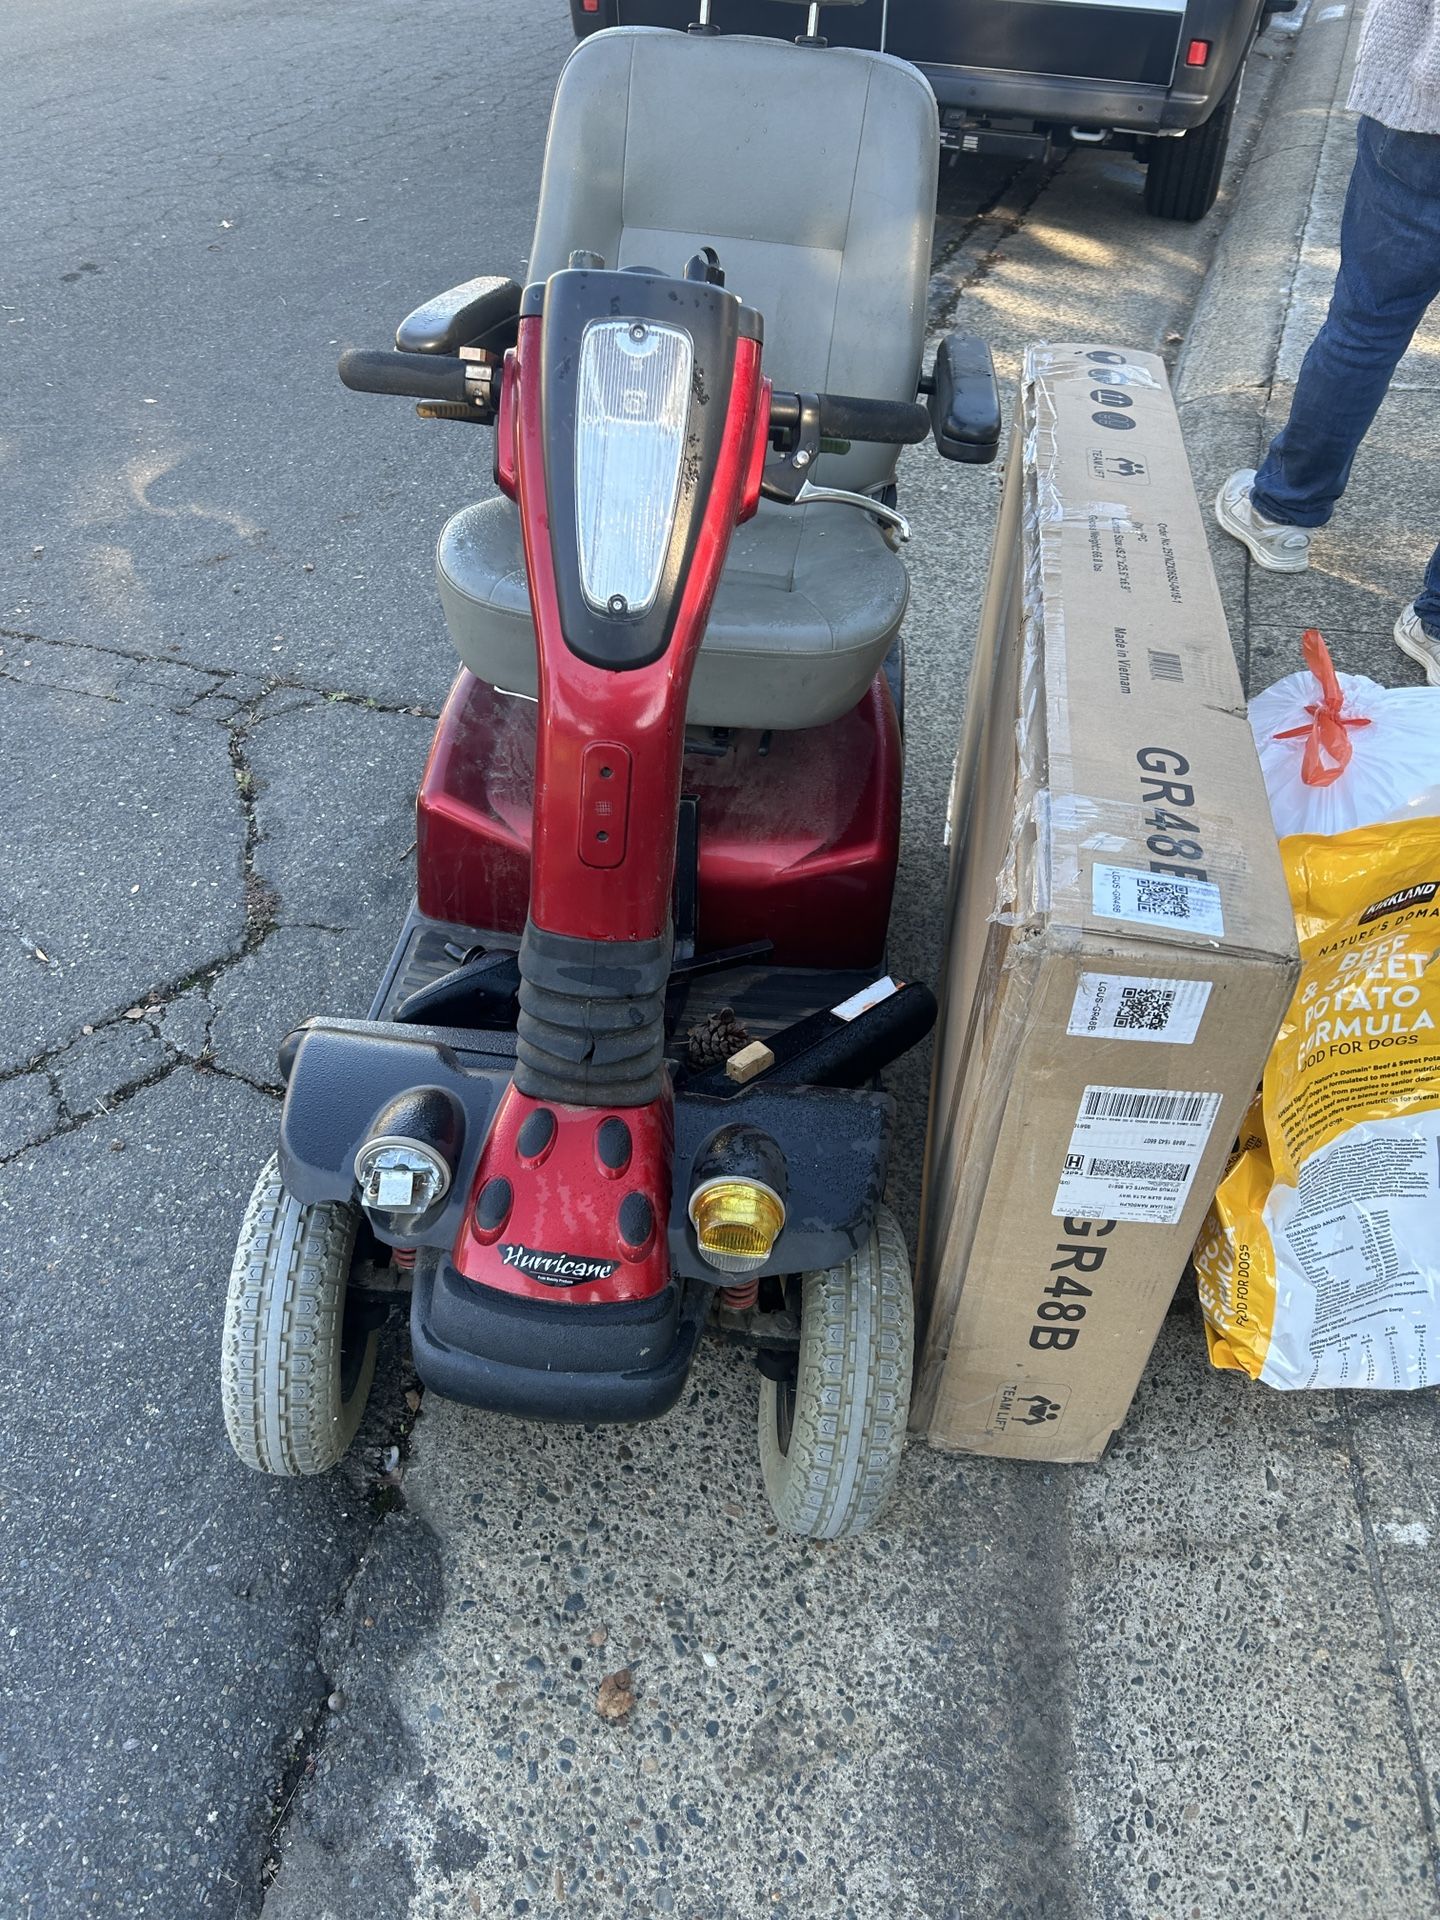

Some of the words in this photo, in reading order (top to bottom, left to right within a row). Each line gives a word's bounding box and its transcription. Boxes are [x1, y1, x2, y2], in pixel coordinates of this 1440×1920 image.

[1092, 450, 1103, 468] TEAM
[1094, 466, 1105, 479] LIFT
[1114, 627, 1127, 649] Made
[1117, 650, 1127, 658] in
[1118, 658, 1131, 694] Vietnam
[1111, 871, 1122, 914] LGUS-GR48B
[1367, 883, 1436, 915] KIRKLAND
[1319, 921, 1388, 957] NATURE'S
[1338, 934, 1411, 972] BEEF
[1087, 981, 1108, 1032] LGUS-GR48B
[1305, 985, 1421, 1032] POTATO
[1329, 1041, 1362, 1057] FOR
[1368, 1035, 1419, 1050] DOGS
[1314, 1072, 1339, 1086] Nature's
[1373, 1062, 1391, 1072] Beef
[1399, 1057, 1422, 1067] Sweet
[1329, 1076, 1368, 1088] formulated
[1380, 1071, 1399, 1079] meet
[1308, 1108, 1323, 1119] Angus
[1323, 1099, 1335, 1110] beef
[1336, 1096, 1350, 1105] and
[1357, 1090, 1378, 1100] blend
[1389, 1086, 1416, 1096] quality
[1331, 1088, 1349, 1097] from
[1350, 1083, 1379, 1094] puppies
[1391, 1079, 1413, 1087] senior
[1328, 1106, 1345, 1118] offers
[1346, 1102, 1365, 1111] great
[503, 1246, 612, 1279] Hurricane
[1239, 1244, 1250, 1282] DOGS
[1029, 1217, 1117, 1350] GR48B
[1238, 1282, 1249, 1304] FOR
[999, 1384, 1017, 1412] TEAM
[994, 1411, 1009, 1432] LIFT
